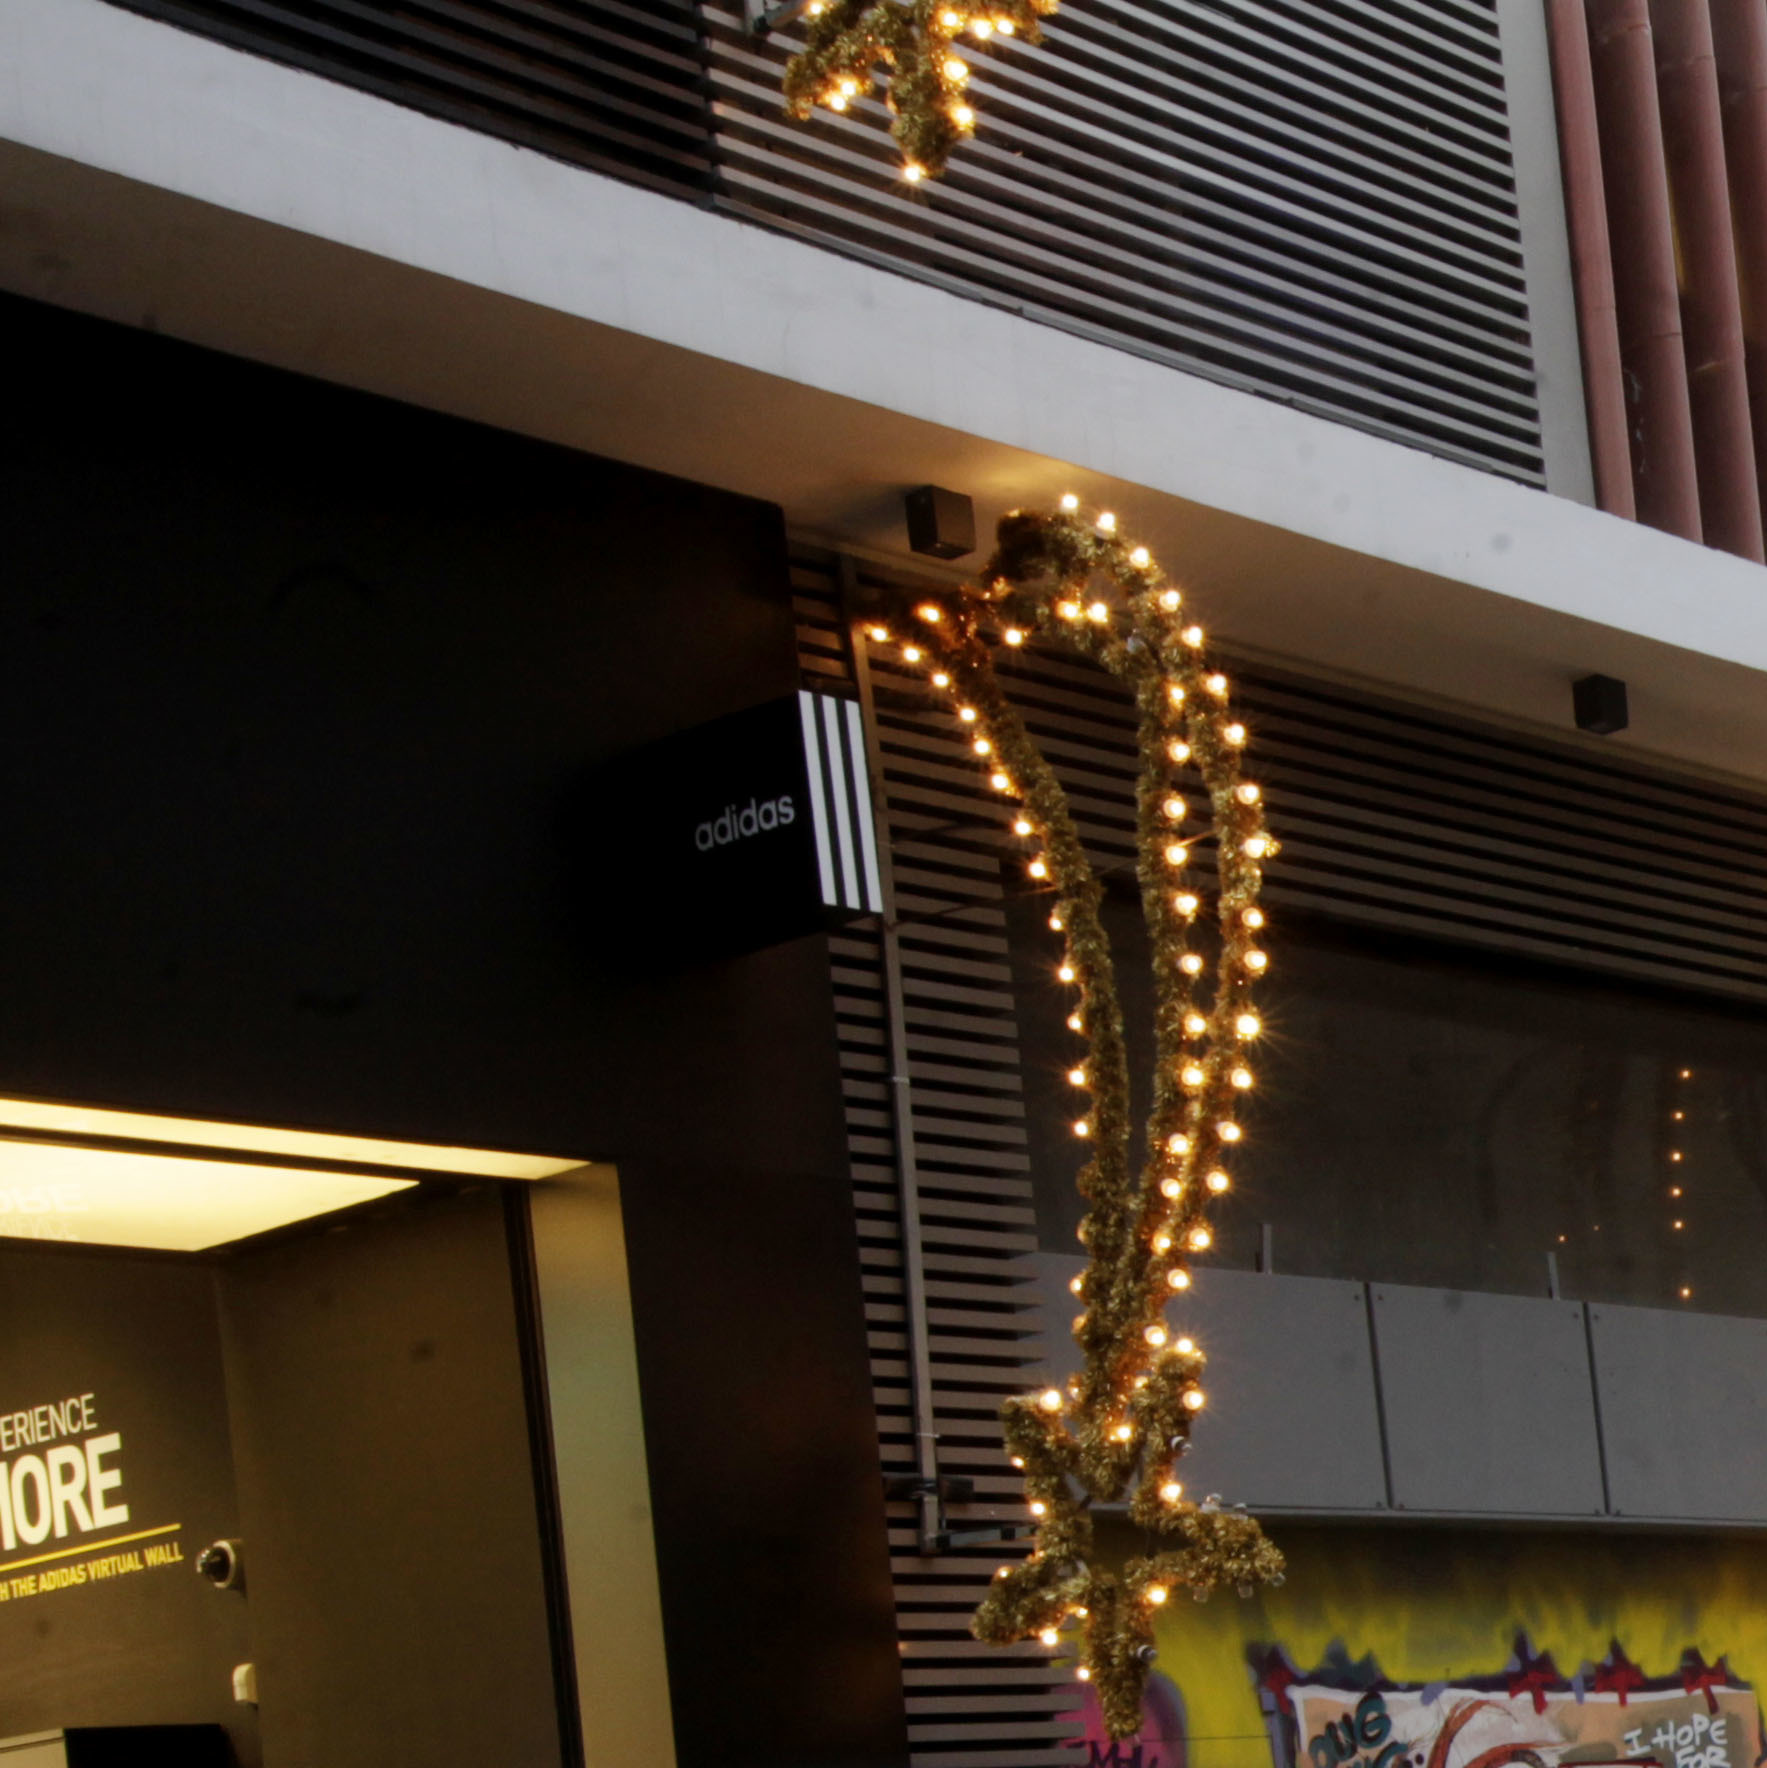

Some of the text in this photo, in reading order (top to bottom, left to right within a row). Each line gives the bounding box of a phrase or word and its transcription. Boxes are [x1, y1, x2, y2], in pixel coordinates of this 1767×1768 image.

[695, 796, 796, 851] adidas
[10, 1574, 38, 1598] THE
[38, 1564, 87, 1592] ADIDAS
[87, 1552, 144, 1584] VIRTUAL
[144, 1542, 184, 1567] WALL
[1624, 1713, 1727, 1756] I HOPE
